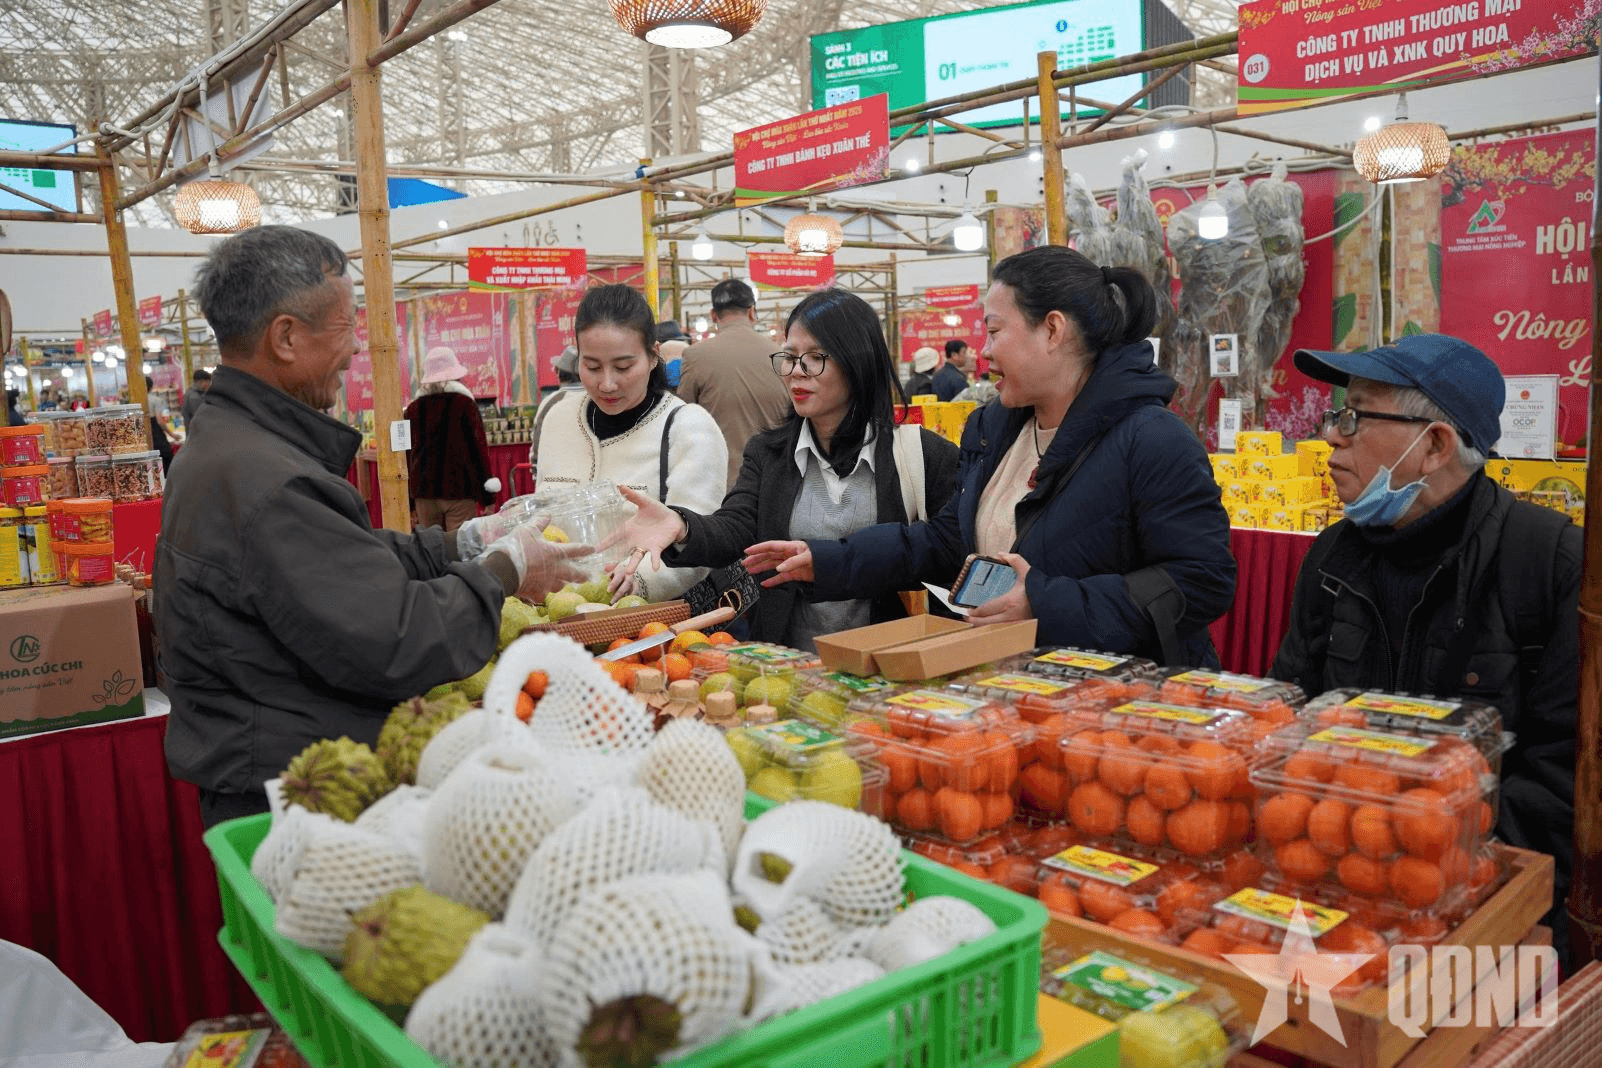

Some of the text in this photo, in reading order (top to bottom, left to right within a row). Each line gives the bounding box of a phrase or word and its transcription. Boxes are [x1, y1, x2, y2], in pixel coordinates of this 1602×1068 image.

[1297, 34, 1337, 58] CÔNG
[1341, 29, 1359, 48] TY
[1363, 18, 1405, 44] TNHH
[1409, 2, 1479, 33] THƯƠNG
[825, 56, 845, 70] CÁC
[939, 62, 957, 80] 01
[1304, 23, 1509, 83] DỊCH VỤ VÀ XNK QUY HOA
[748, 130, 871, 174] CÔNG TY TNHH BÁNH KẸO XUÂN THẾ
[1536, 216, 1586, 259] HỘI
[1552, 263, 1589, 285] LẦN
[1494, 310, 1590, 349] Nông
[32, 662, 59, 675] CÚC
[61, 660, 83, 671] CHI
